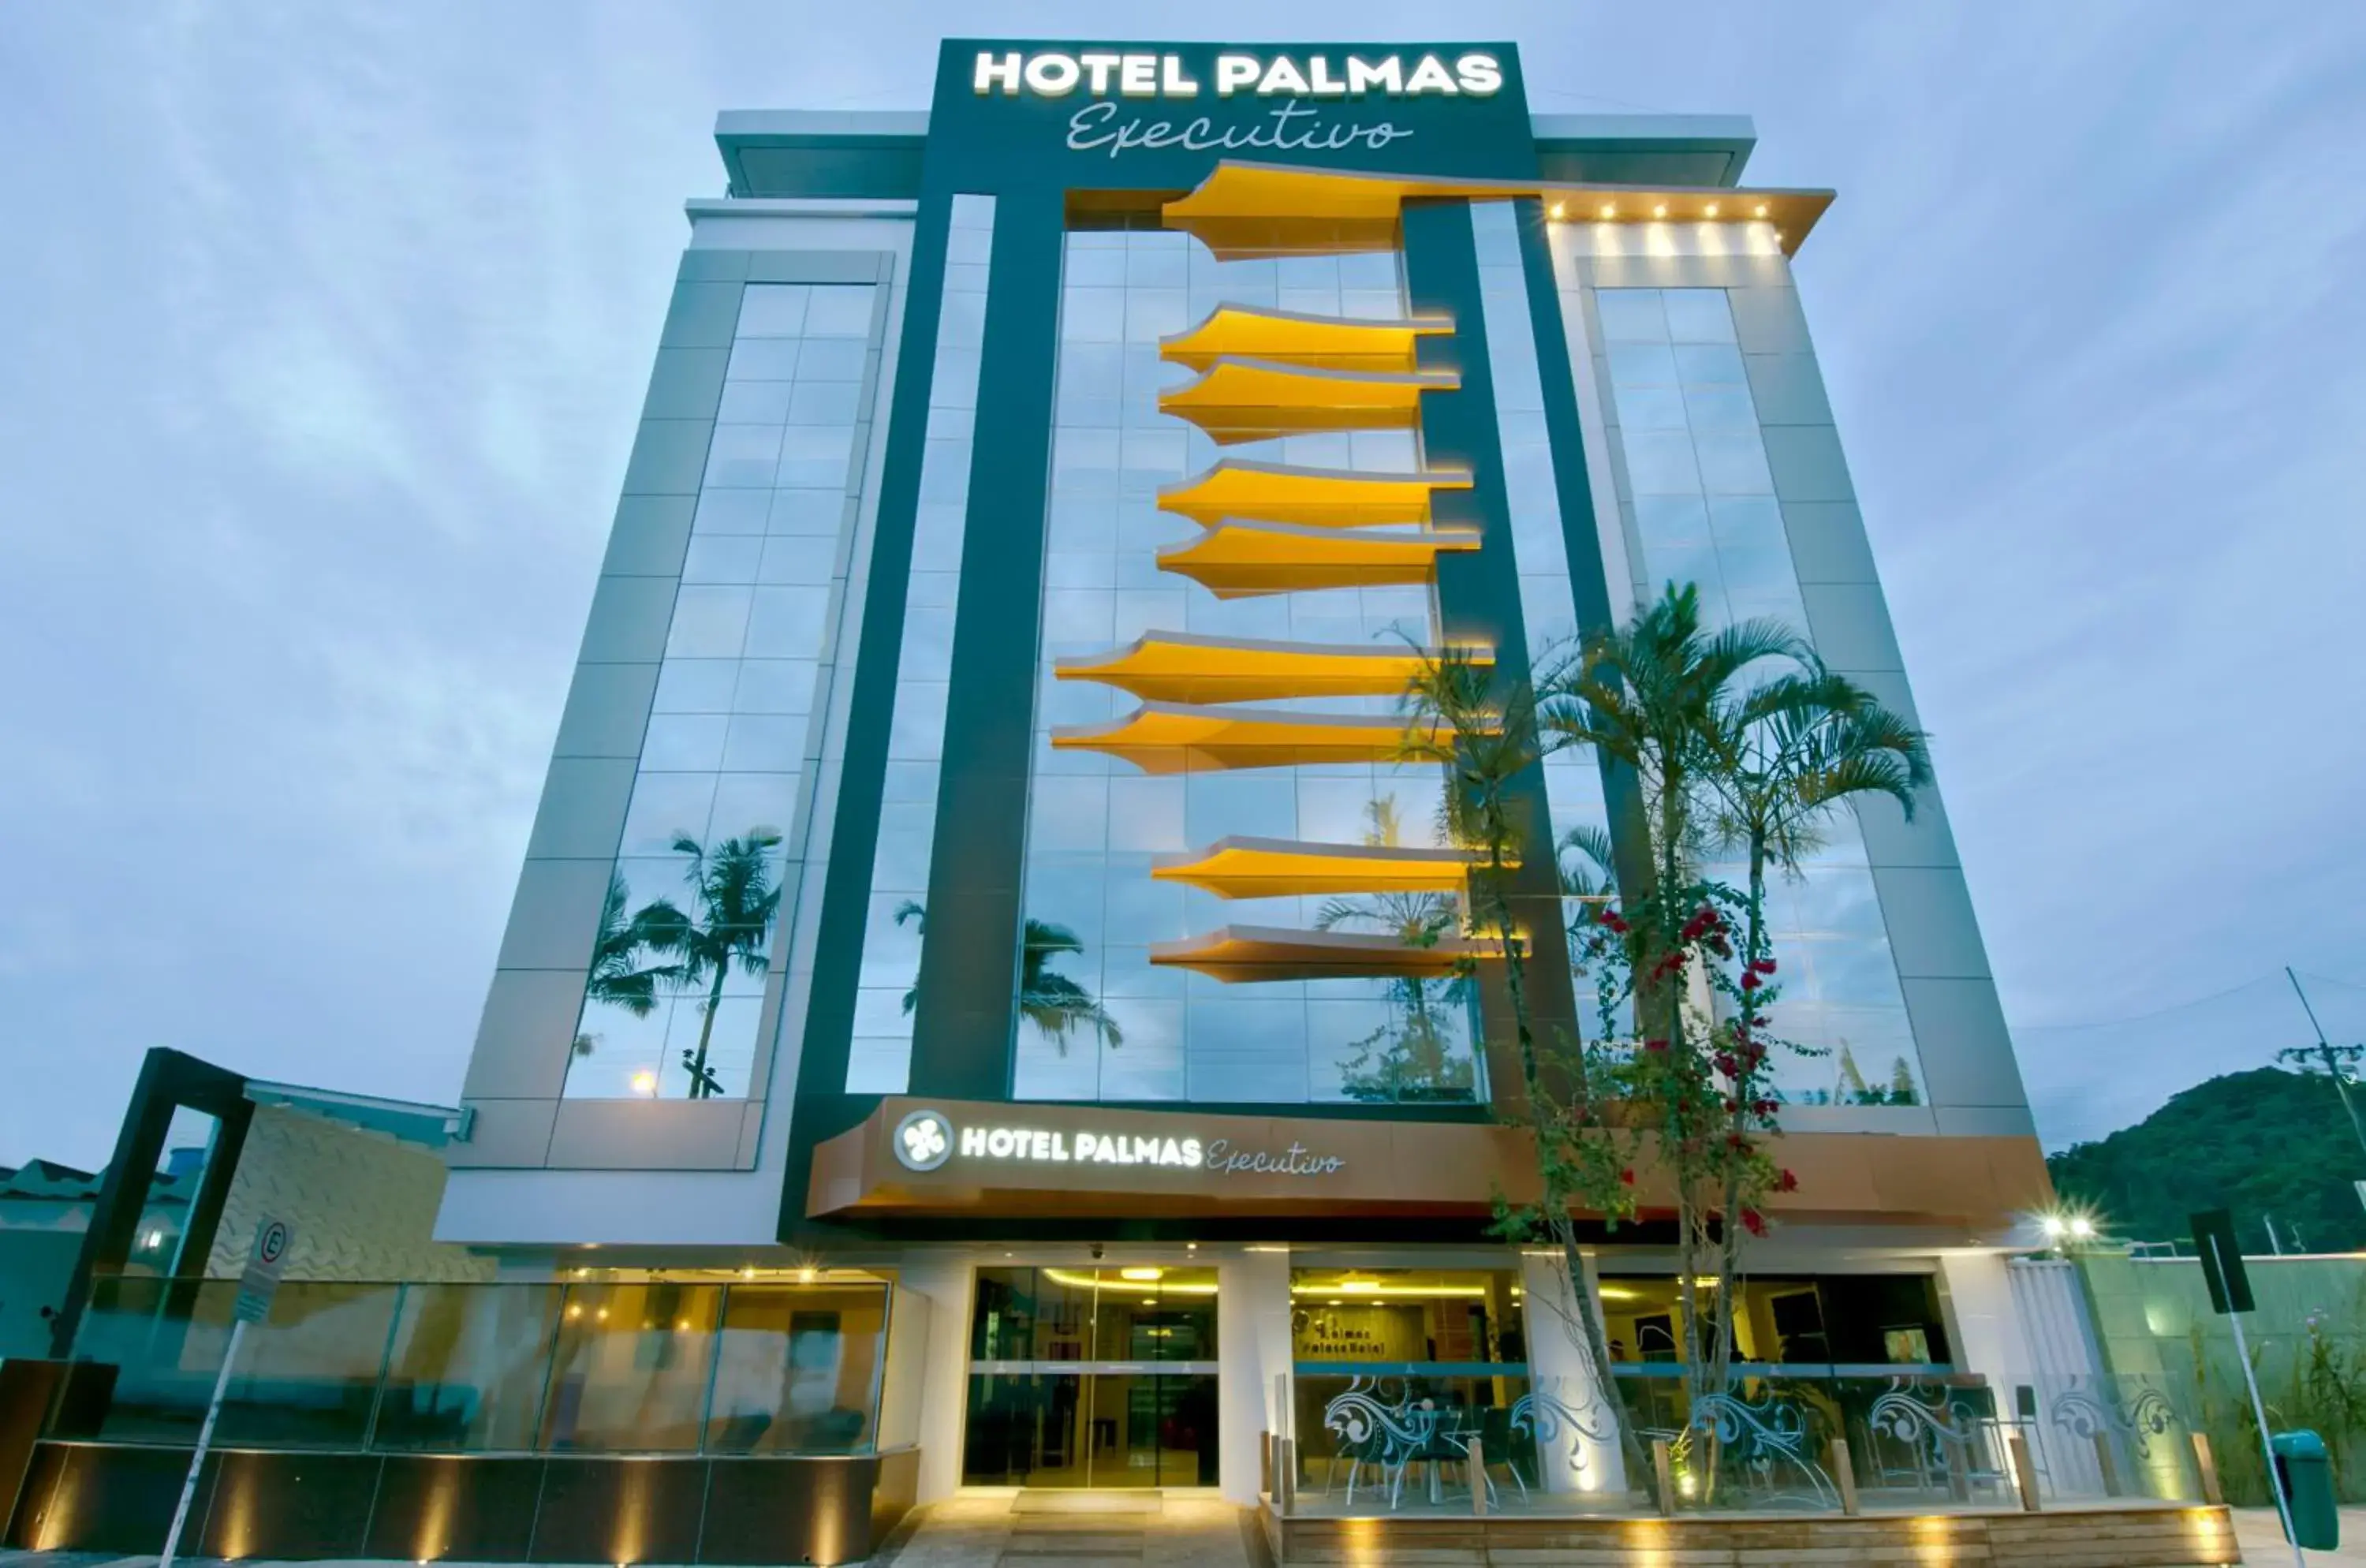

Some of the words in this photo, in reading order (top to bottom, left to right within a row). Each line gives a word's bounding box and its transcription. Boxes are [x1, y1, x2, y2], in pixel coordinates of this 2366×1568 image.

[974, 53, 1198, 97] HOTEL
[1218, 54, 1502, 98] PALMAS
[1066, 99, 1414, 158] Executivo
[961, 1127, 1069, 1160] HOTEL
[1074, 1133, 1203, 1167] PALMAS
[1206, 1139, 1346, 1175] Executivo
[267, 1230, 282, 1254] E
